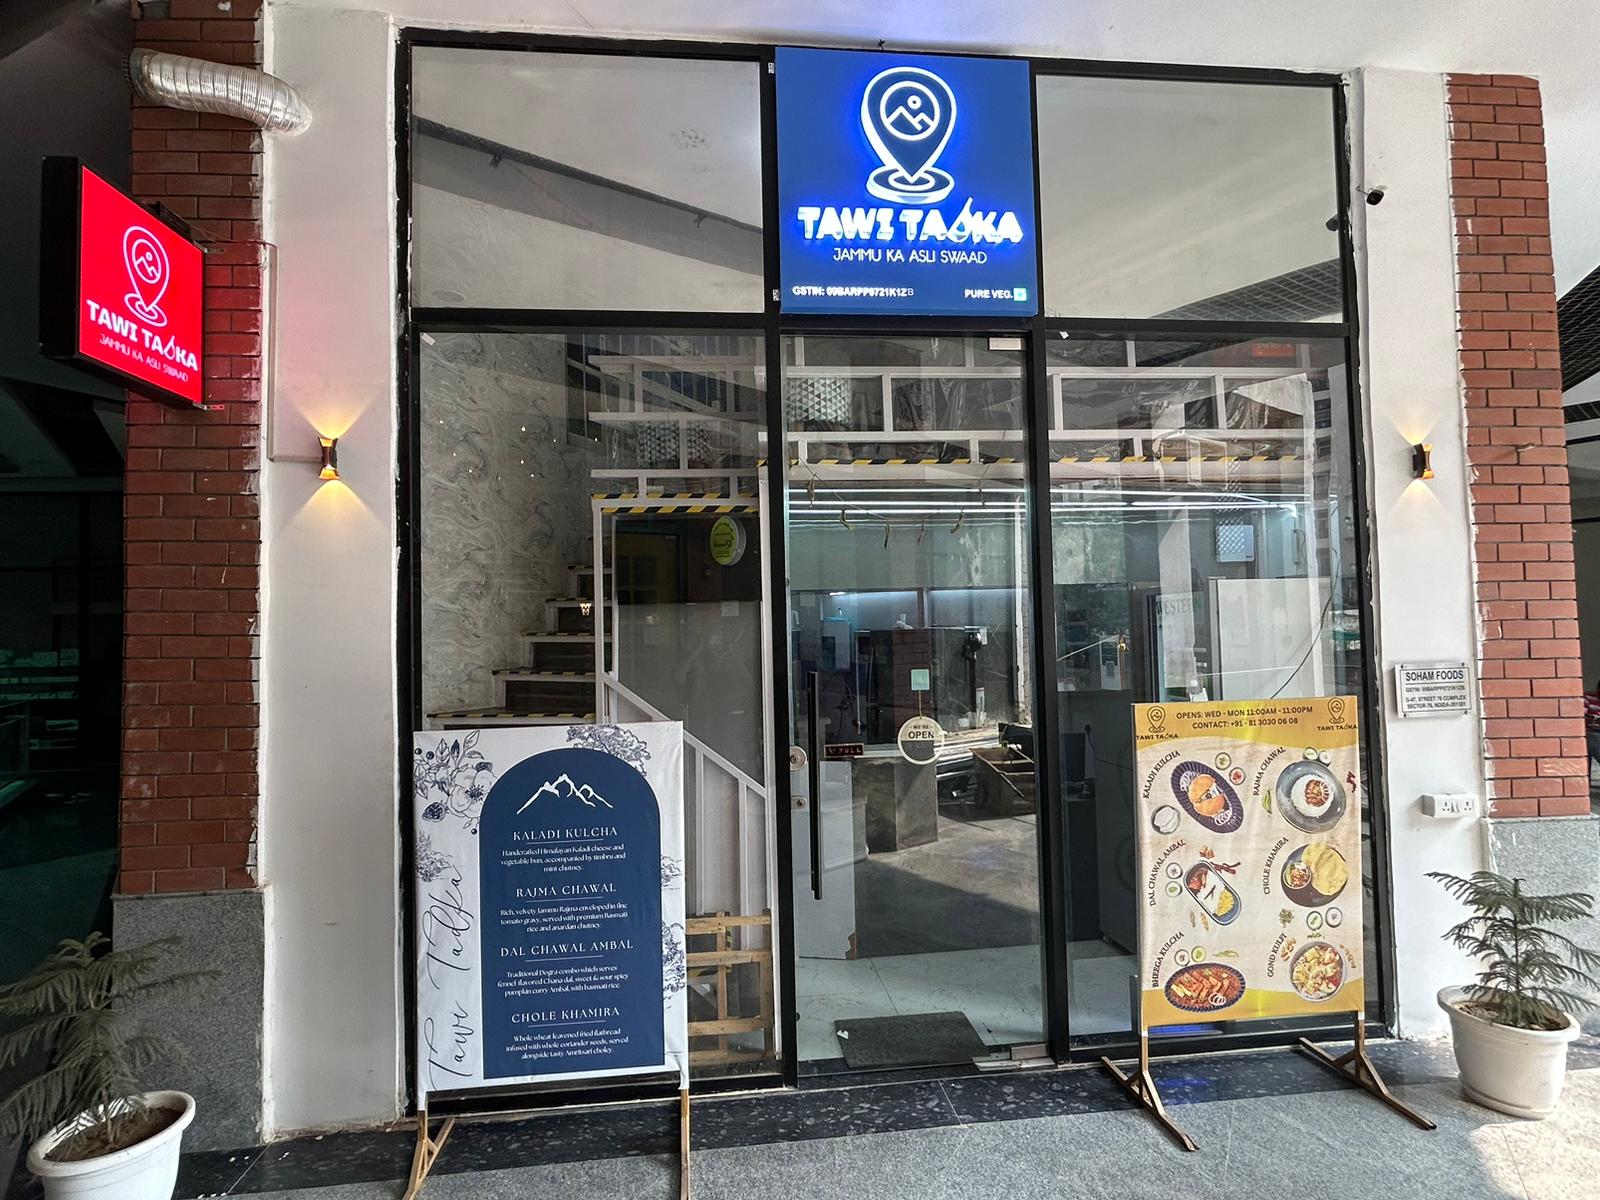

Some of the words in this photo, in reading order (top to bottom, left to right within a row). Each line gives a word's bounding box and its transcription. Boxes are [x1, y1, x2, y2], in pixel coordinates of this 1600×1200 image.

[797, 206, 895, 241] TAWI
[833, 248, 882, 262] JAMMU
[886, 248, 905, 263] KA
[909, 249, 936, 264] ASLI
[940, 249, 987, 264] SWAAD
[792, 285, 825, 297] GSTIN:
[964, 288, 990, 299] PURE
[991, 289, 1013, 300] VEG.
[86, 299, 138, 343] TAWI
[100, 333, 131, 356] JAMMU
[132, 349, 144, 363] KA
[1405, 671, 1435, 682] SOHAM
[1436, 670, 1464, 680] FOODS
[1176, 711, 1203, 719] OPENS:
[1204, 710, 1222, 718] WED
[1227, 709, 1245, 717] MON
[1246, 708, 1277, 716] 11:00AM
[1282, 706, 1313, 714] 11:00PM
[1192, 721, 1229, 730] CONTACT:
[1230, 720, 1243, 728] +91
[1257, 718, 1277, 726] 3030
[1277, 717, 1288, 725] 06
[908, 730, 934, 739] OPEN
[1260, 746, 1287, 771] CHAWAL
[1142, 770, 1158, 799] KALADI
[1153, 750, 1181, 773] KULCHA
[513, 829, 560, 841] KALADI
[565, 826, 618, 839] KULCHA
[612, 843, 624, 851] and
[614, 852, 626, 860] and
[1162, 839, 1187, 859] AMBAL
[1264, 836, 1290, 868] KHAMIRA
[1148, 857, 1165, 890] CHAWAL
[1262, 868, 1271, 895] CHOLE
[516, 886, 557, 898] RAJMA
[561, 883, 617, 895] CHAWAL
[1148, 889, 1156, 907] DAL
[422, 865, 474, 990] Tadka
[500, 947, 526, 957] DAL
[531, 943, 586, 956] CHAWAL
[590, 940, 633, 952] AMBAL
[1159, 931, 1185, 957] KULCHA
[1271, 932, 1287, 954] KULFI
[511, 1011, 557, 1023] CHOLE
[561, 1007, 620, 1020] KHAMIRA
[424, 1000, 474, 1091] Tawi
